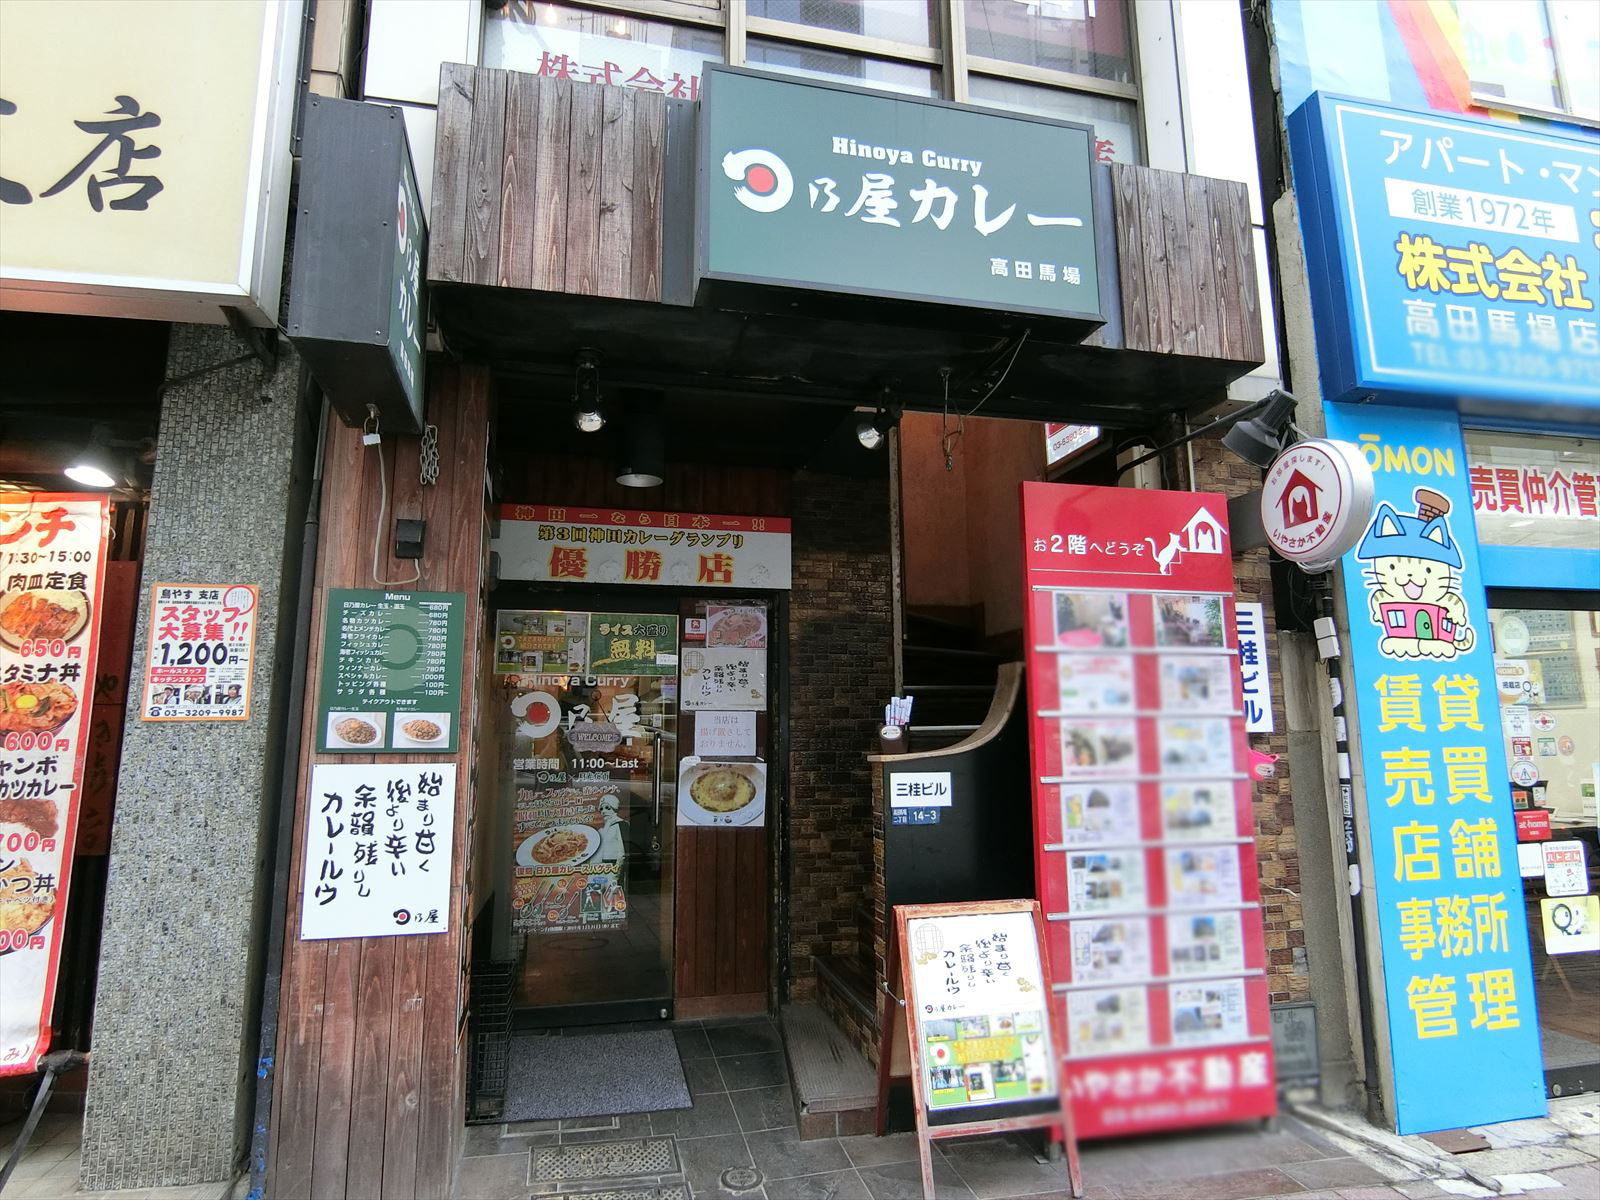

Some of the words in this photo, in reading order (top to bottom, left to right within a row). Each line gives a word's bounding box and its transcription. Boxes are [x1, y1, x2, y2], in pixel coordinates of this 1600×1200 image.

[0, 95, 165, 213] 店
[832, 136, 914, 166] Hinoya
[922, 150, 983, 177] Curry
[1411, 187, 1555, 233] 創業1972年
[990, 257, 1081, 285] 高田馬場
[1396, 232, 1594, 310] 株式会社
[1402, 298, 1599, 355] 高田馬場店
[1468, 464, 1600, 518] 売買仲介管
[538, 525, 744, 549] 第3回神田カレーグランプリ
[1272, 510, 1333, 548] いやさか不動産
[1033, 533, 1145, 557] お2階へどうぞ
[549, 544, 735, 585] 優勝店
[7, 571, 88, 591] 肉皿定食
[161, 588, 193, 599] 鳥やす
[198, 590, 219, 599] 支店
[385, 593, 411, 601] Menu
[161, 605, 242, 623] スタッフ
[600, 623, 668, 637] ライス大盛り
[20, 639, 82, 659] 650円
[610, 637, 657, 661] 無料
[0, 663, 81, 683] タミナ丼
[156, 667, 202, 675] ホールスタッフ
[585, 675, 630, 688] Curry
[336, 688, 386, 696] サラダ各種
[1373, 673, 1484, 733] 賃貸
[164, 709, 244, 717] 03-3209-9987
[713, 715, 739, 724] 当店は
[5, 731, 70, 752] 600円
[578, 732, 613, 742] WELCOME
[513, 758, 560, 770] 営業時間
[1381, 746, 1494, 807] 売買
[896, 782, 947, 796] 三桂ビル
[384, 779, 411, 876] 後より辛い
[415, 772, 443, 872] 始まり甘く
[913, 810, 937, 821] 14-3
[0, 831, 57, 853] 00円
[315, 791, 344, 906] カレールウ
[350, 784, 378, 898] 余韻残りし
[1392, 818, 1502, 882] 店舗
[1396, 892, 1509, 960] 事務所
[1406, 968, 1521, 1040] 管理
